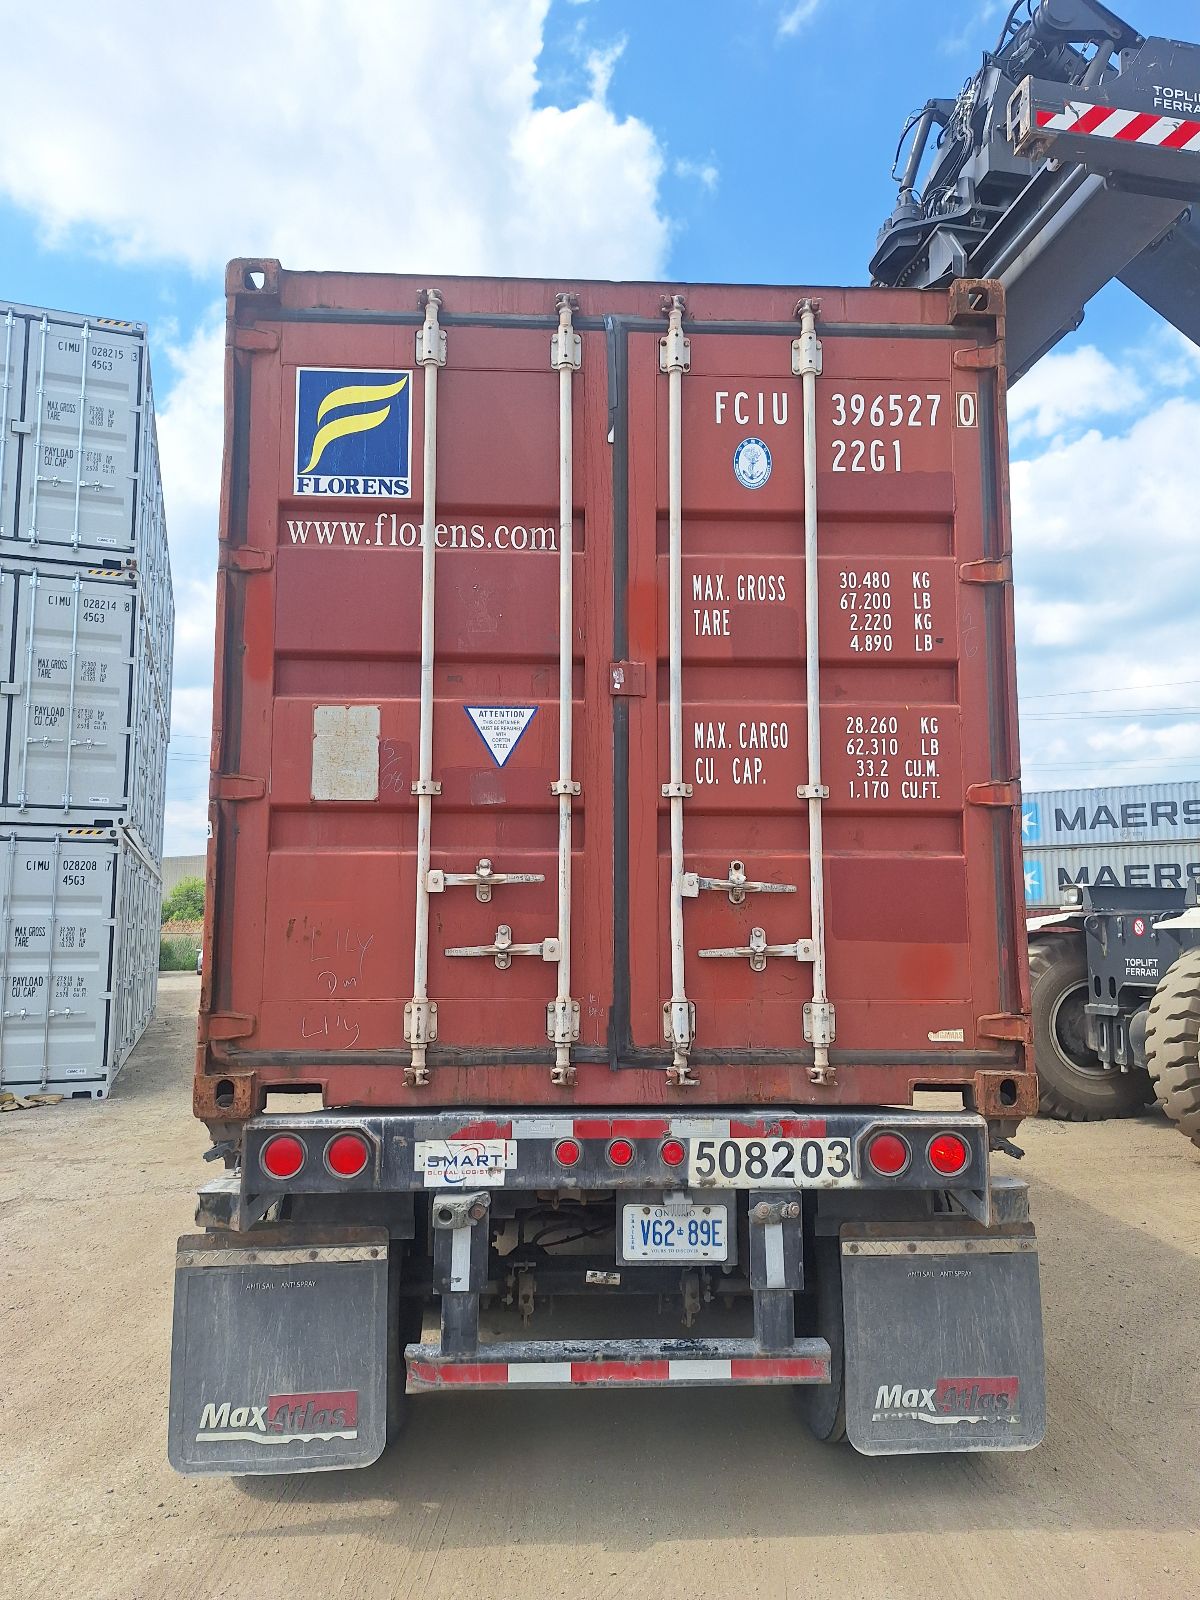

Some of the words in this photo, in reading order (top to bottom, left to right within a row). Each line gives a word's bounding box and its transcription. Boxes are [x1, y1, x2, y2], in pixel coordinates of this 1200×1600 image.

[1152, 85, 1200, 102] TOPLI
[58, 341, 80, 353] CIMU
[91, 346, 124, 360] 028215
[91, 360, 113, 371] 45G3
[47, 410, 61, 421] TARE
[714, 391, 788, 425] FCIU
[831, 393, 942, 427] 396527
[959, 394, 975, 426] 0
[44, 446, 74, 459] PAYLOAD
[831, 439, 902, 473] 22G1
[296, 477, 409, 496] FLORENS
[692, 574, 730, 601] MAX.
[737, 574, 786, 601] GROSS
[839, 571, 890, 589] 30,480
[912, 571, 930, 589] KG
[48, 595, 71, 607] CIMU
[83, 599, 117, 611] 028214
[840, 592, 891, 610] 67,200
[914, 592, 931, 609] LB
[83, 612, 105, 623] 45G3
[693, 609, 731, 636] TARE
[850, 613, 892, 631] 2,220
[914, 613, 932, 630] KG
[850, 634, 893, 652] 4,890
[915, 634, 933, 651] LB
[38, 668, 51, 679] TARE
[34, 706, 65, 718] PAYLOAD
[478, 710, 525, 718] ATTENTION
[694, 722, 732, 749] MAX.
[739, 722, 789, 749] CARGO
[846, 716, 898, 734] 28,260
[920, 717, 939, 734] KG
[846, 738, 898, 756] 62,310
[921, 738, 939, 756] LB
[695, 757, 719, 785] CU.
[732, 757, 767, 785] CAP.
[856, 759, 889, 777] 33.2
[849, 781, 889, 799] 1,170
[1054, 799, 1200, 832] MAERS
[26, 860, 50, 871] CIMU
[63, 860, 97, 871] 028208
[62, 875, 85, 886] 45G3
[14, 937, 30, 948] TARE
[1124, 958, 1159, 967] TOPLIFT
[1125, 968, 1159, 977] FERRARI
[12, 976, 44, 987] PAYLOAD
[427, 1154, 503, 1168] SMART
[695, 1140, 851, 1179] 508203
